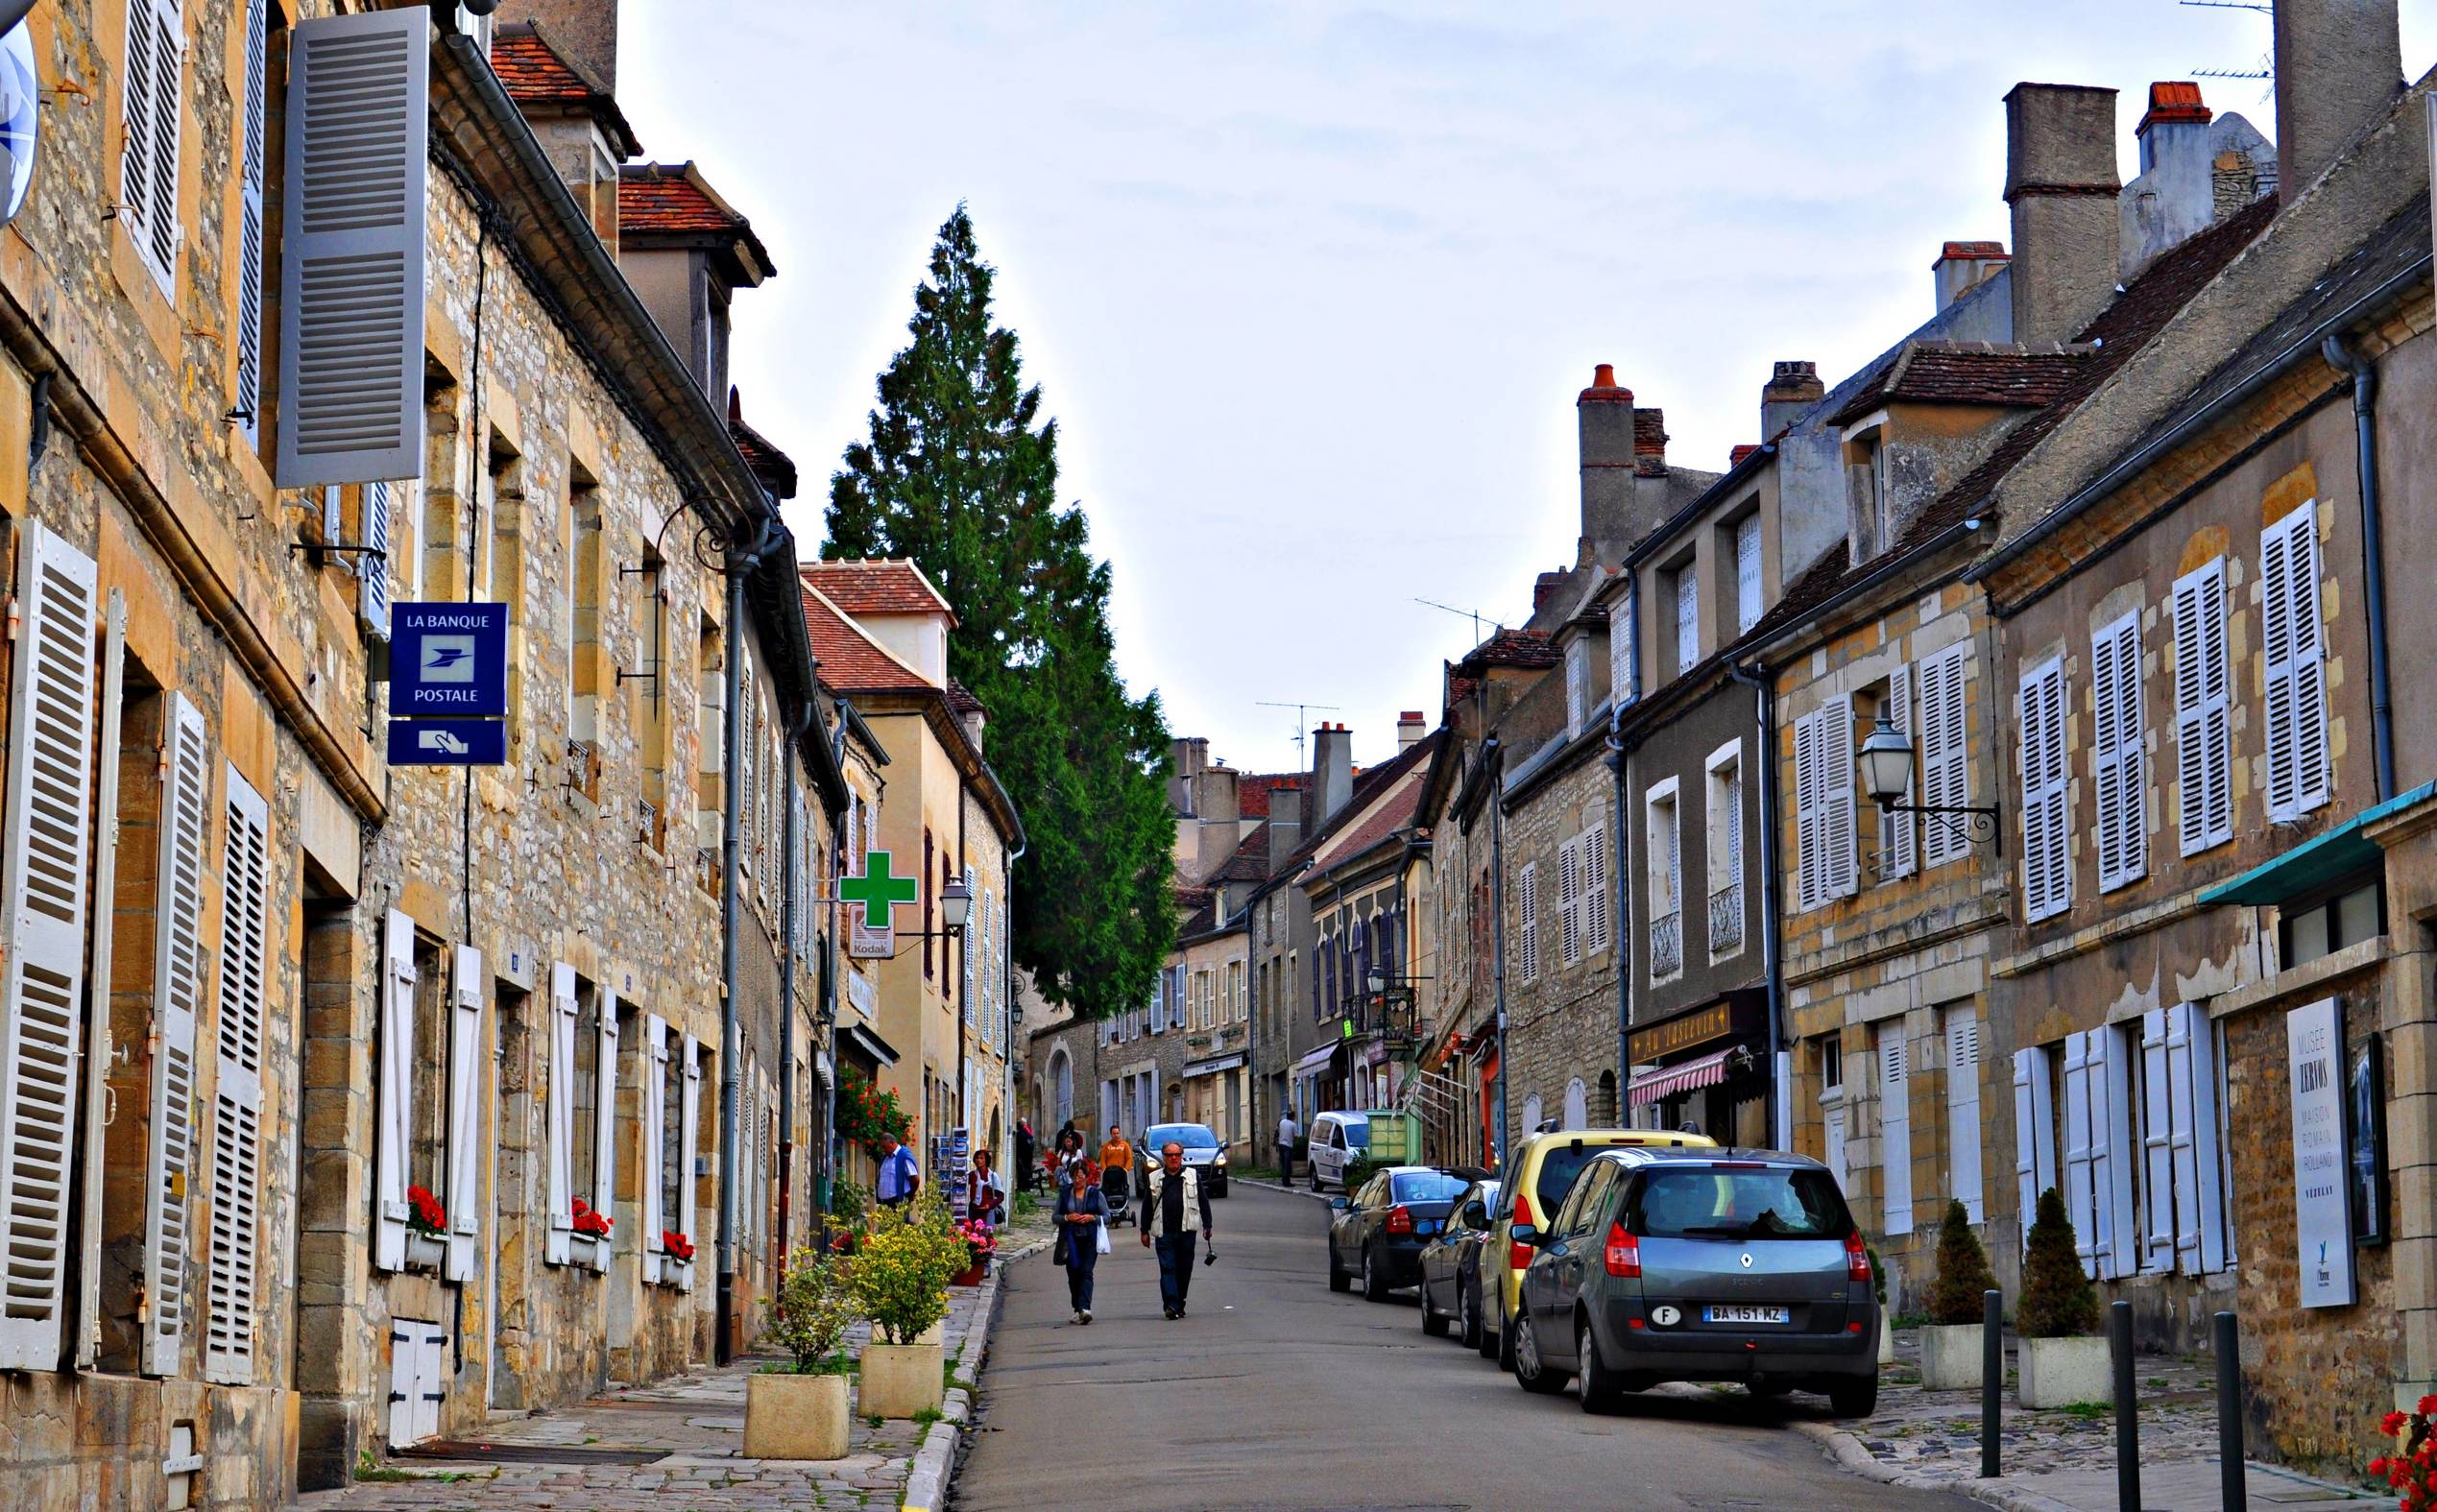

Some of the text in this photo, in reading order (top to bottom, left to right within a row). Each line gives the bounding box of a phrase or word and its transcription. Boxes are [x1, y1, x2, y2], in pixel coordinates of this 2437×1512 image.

[406, 615, 490, 629] LA BANQUE
[414, 689, 478, 702] POSTALE
[854, 944, 888, 954] Kodak
[2299, 1057, 2328, 1094] ZERVOS
[1662, 1308, 1670, 1322] F
